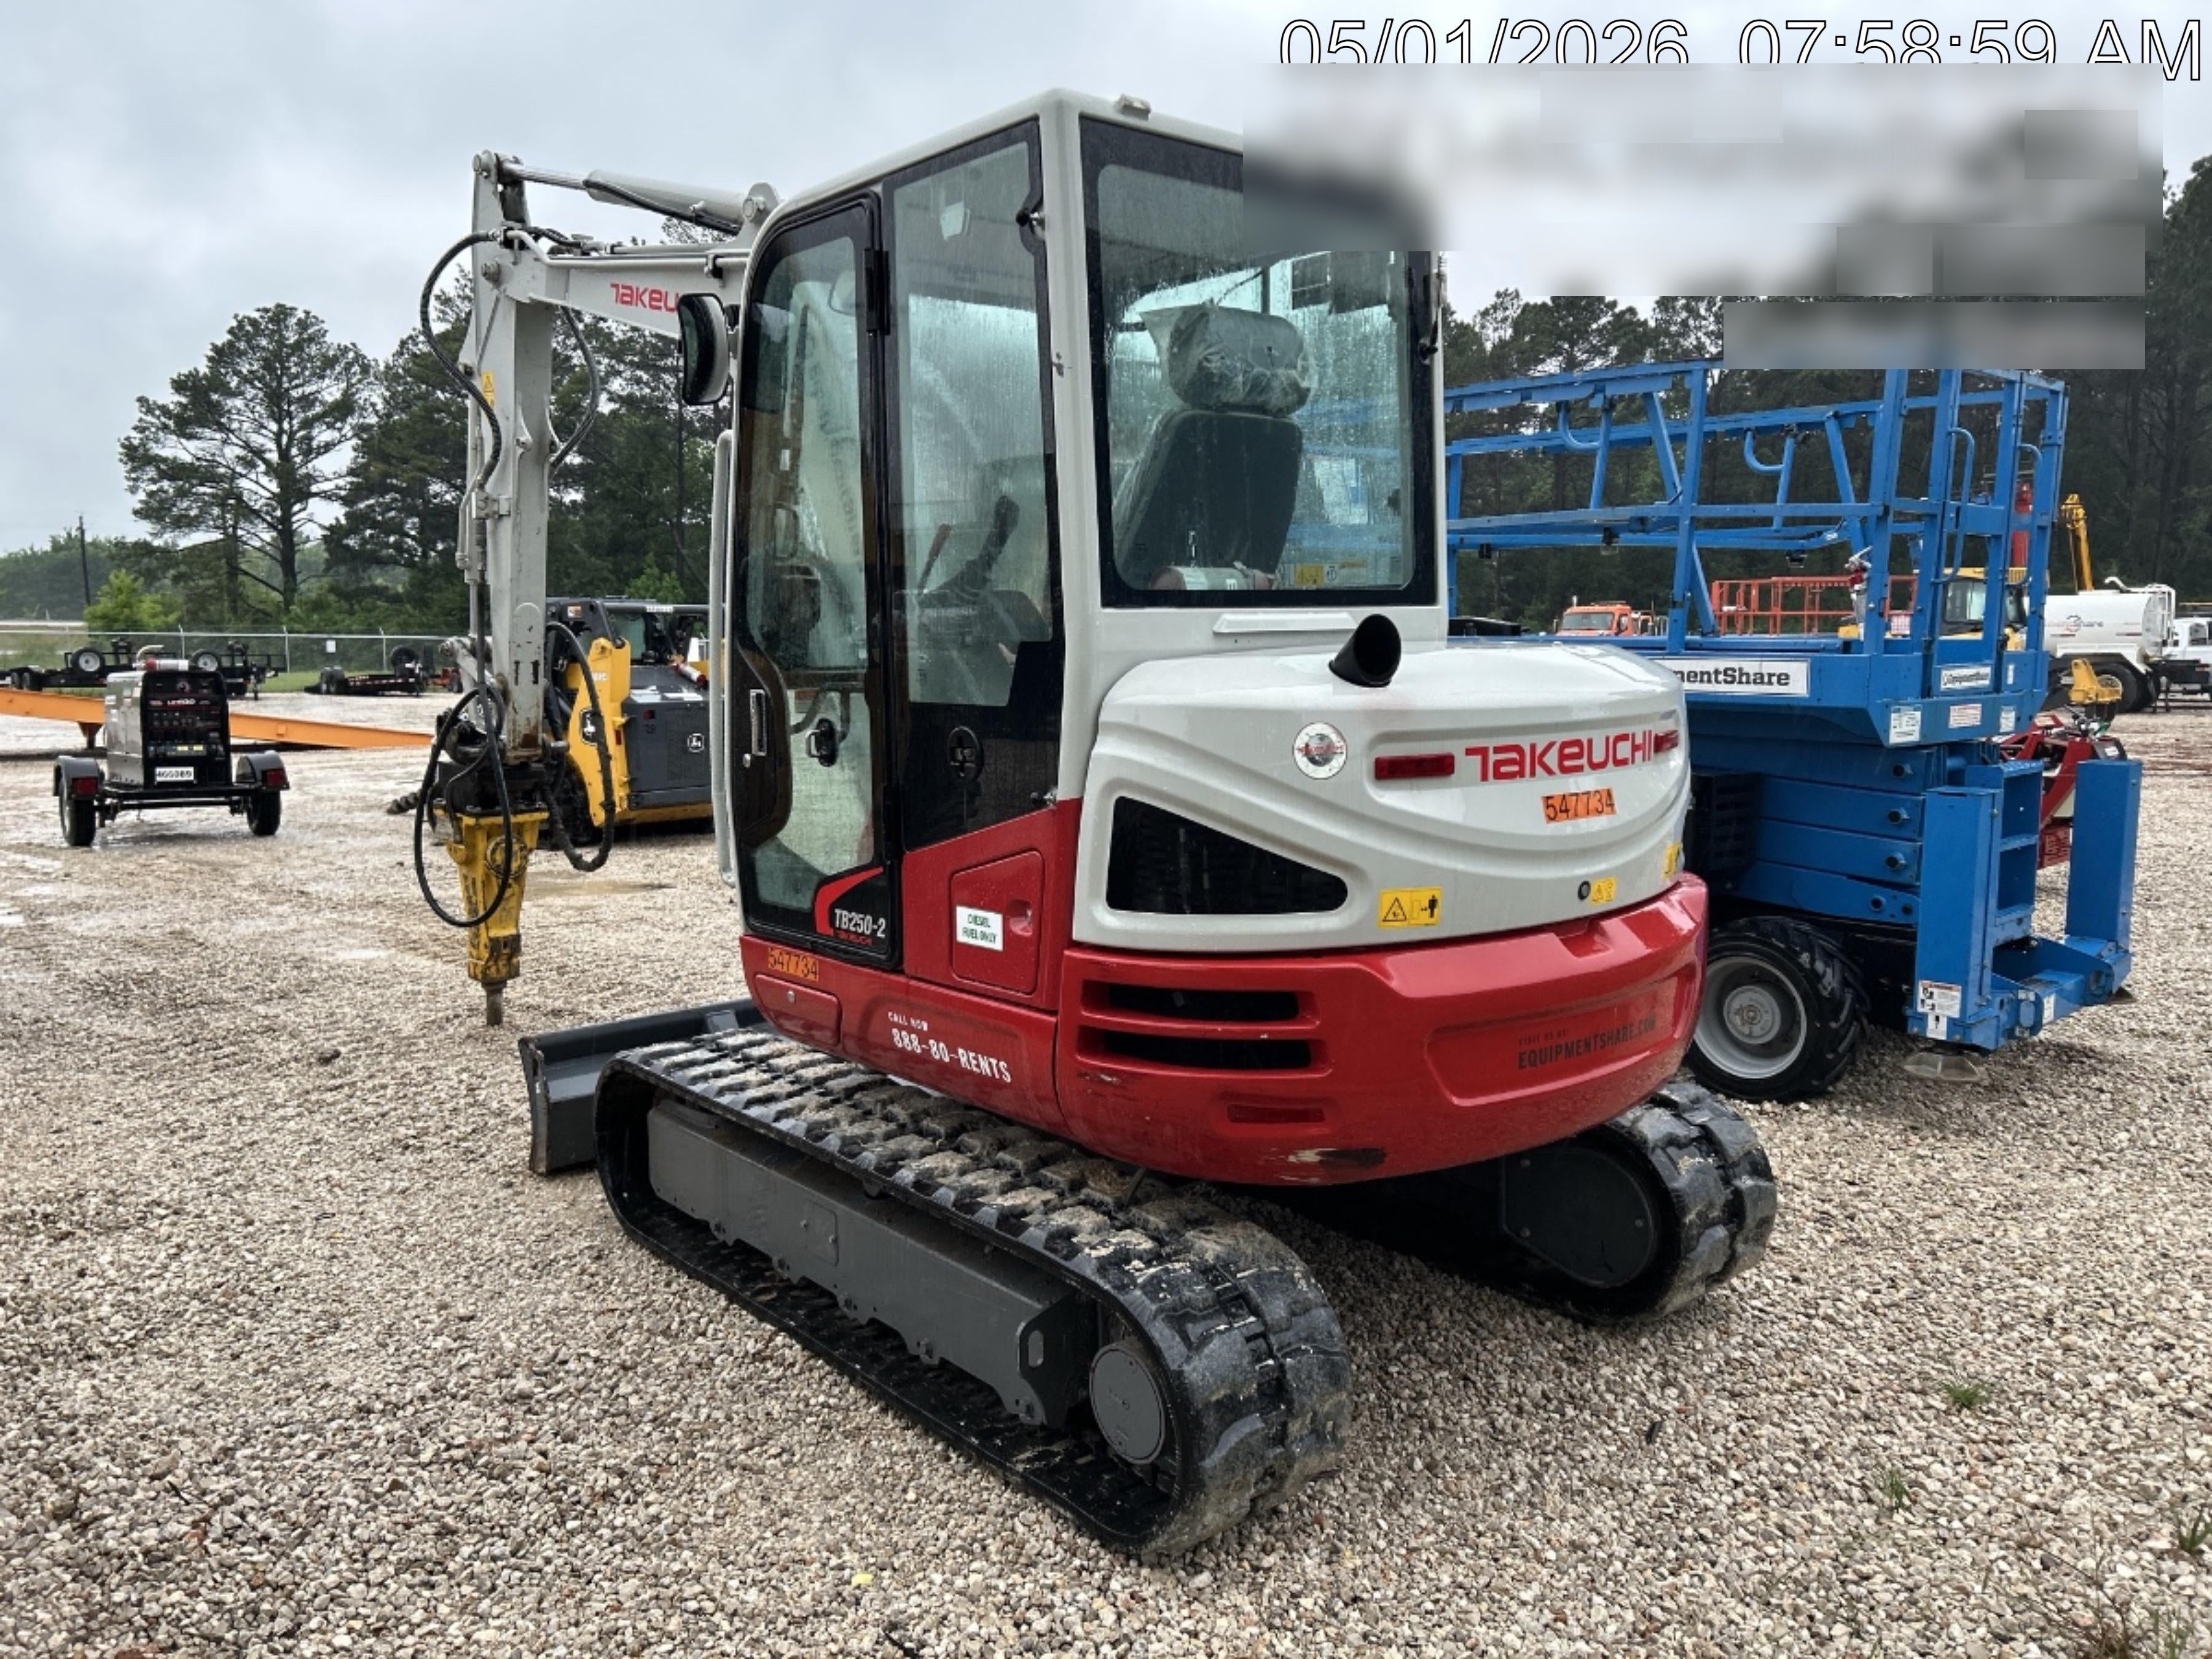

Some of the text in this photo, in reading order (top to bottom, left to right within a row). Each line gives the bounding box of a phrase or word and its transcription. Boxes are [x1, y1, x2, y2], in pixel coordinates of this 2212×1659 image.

[1544, 788, 1615, 822] 547734
[834, 908, 885, 938] TB250-2
[962, 927, 979, 941] FUEL
[767, 947, 817, 979] 547734
[888, 1011, 928, 1031] CALL NOW
[892, 1028, 1011, 1083] 888-80-RENTS
